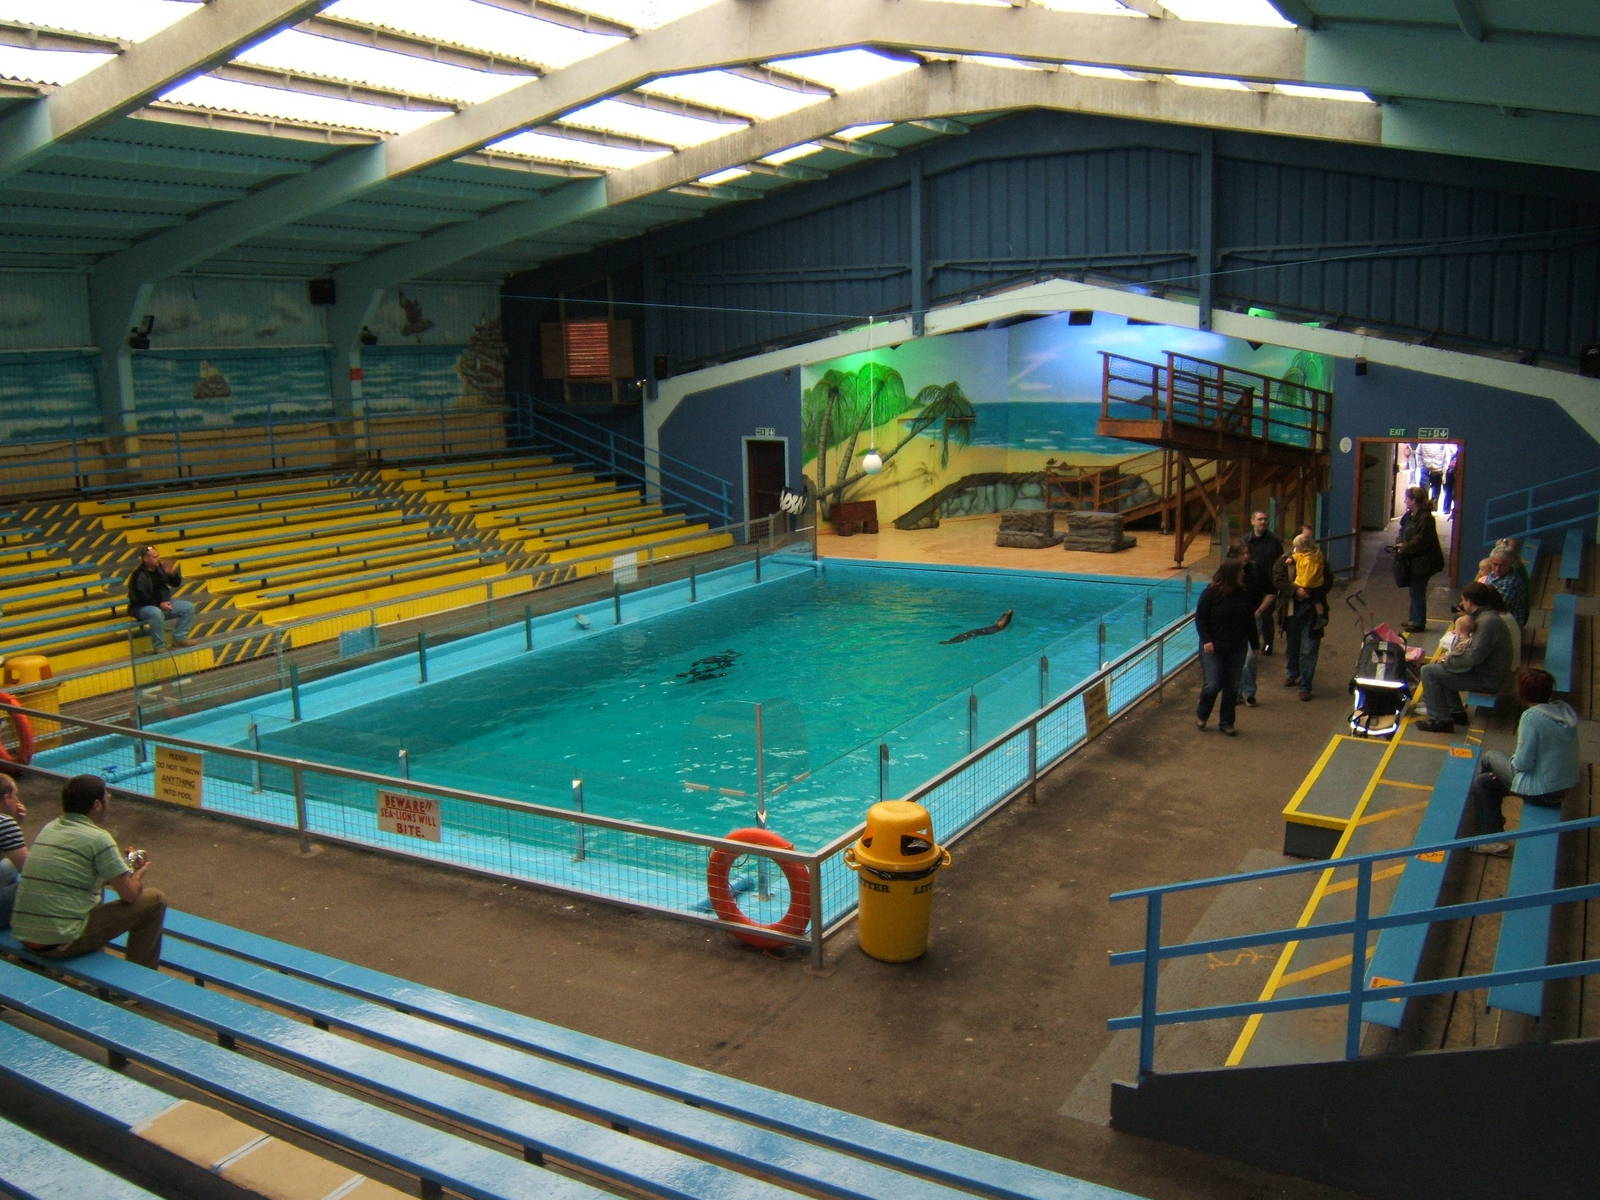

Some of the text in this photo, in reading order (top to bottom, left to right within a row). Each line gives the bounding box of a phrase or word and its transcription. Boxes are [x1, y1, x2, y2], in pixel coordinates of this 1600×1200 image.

[1389, 428, 1406, 437] EXIT
[162, 775, 195, 788] ANYTHING
[178, 791, 192, 800] POOL
[418, 815, 436, 827] WILL
[396, 823, 424, 838] BITE.
